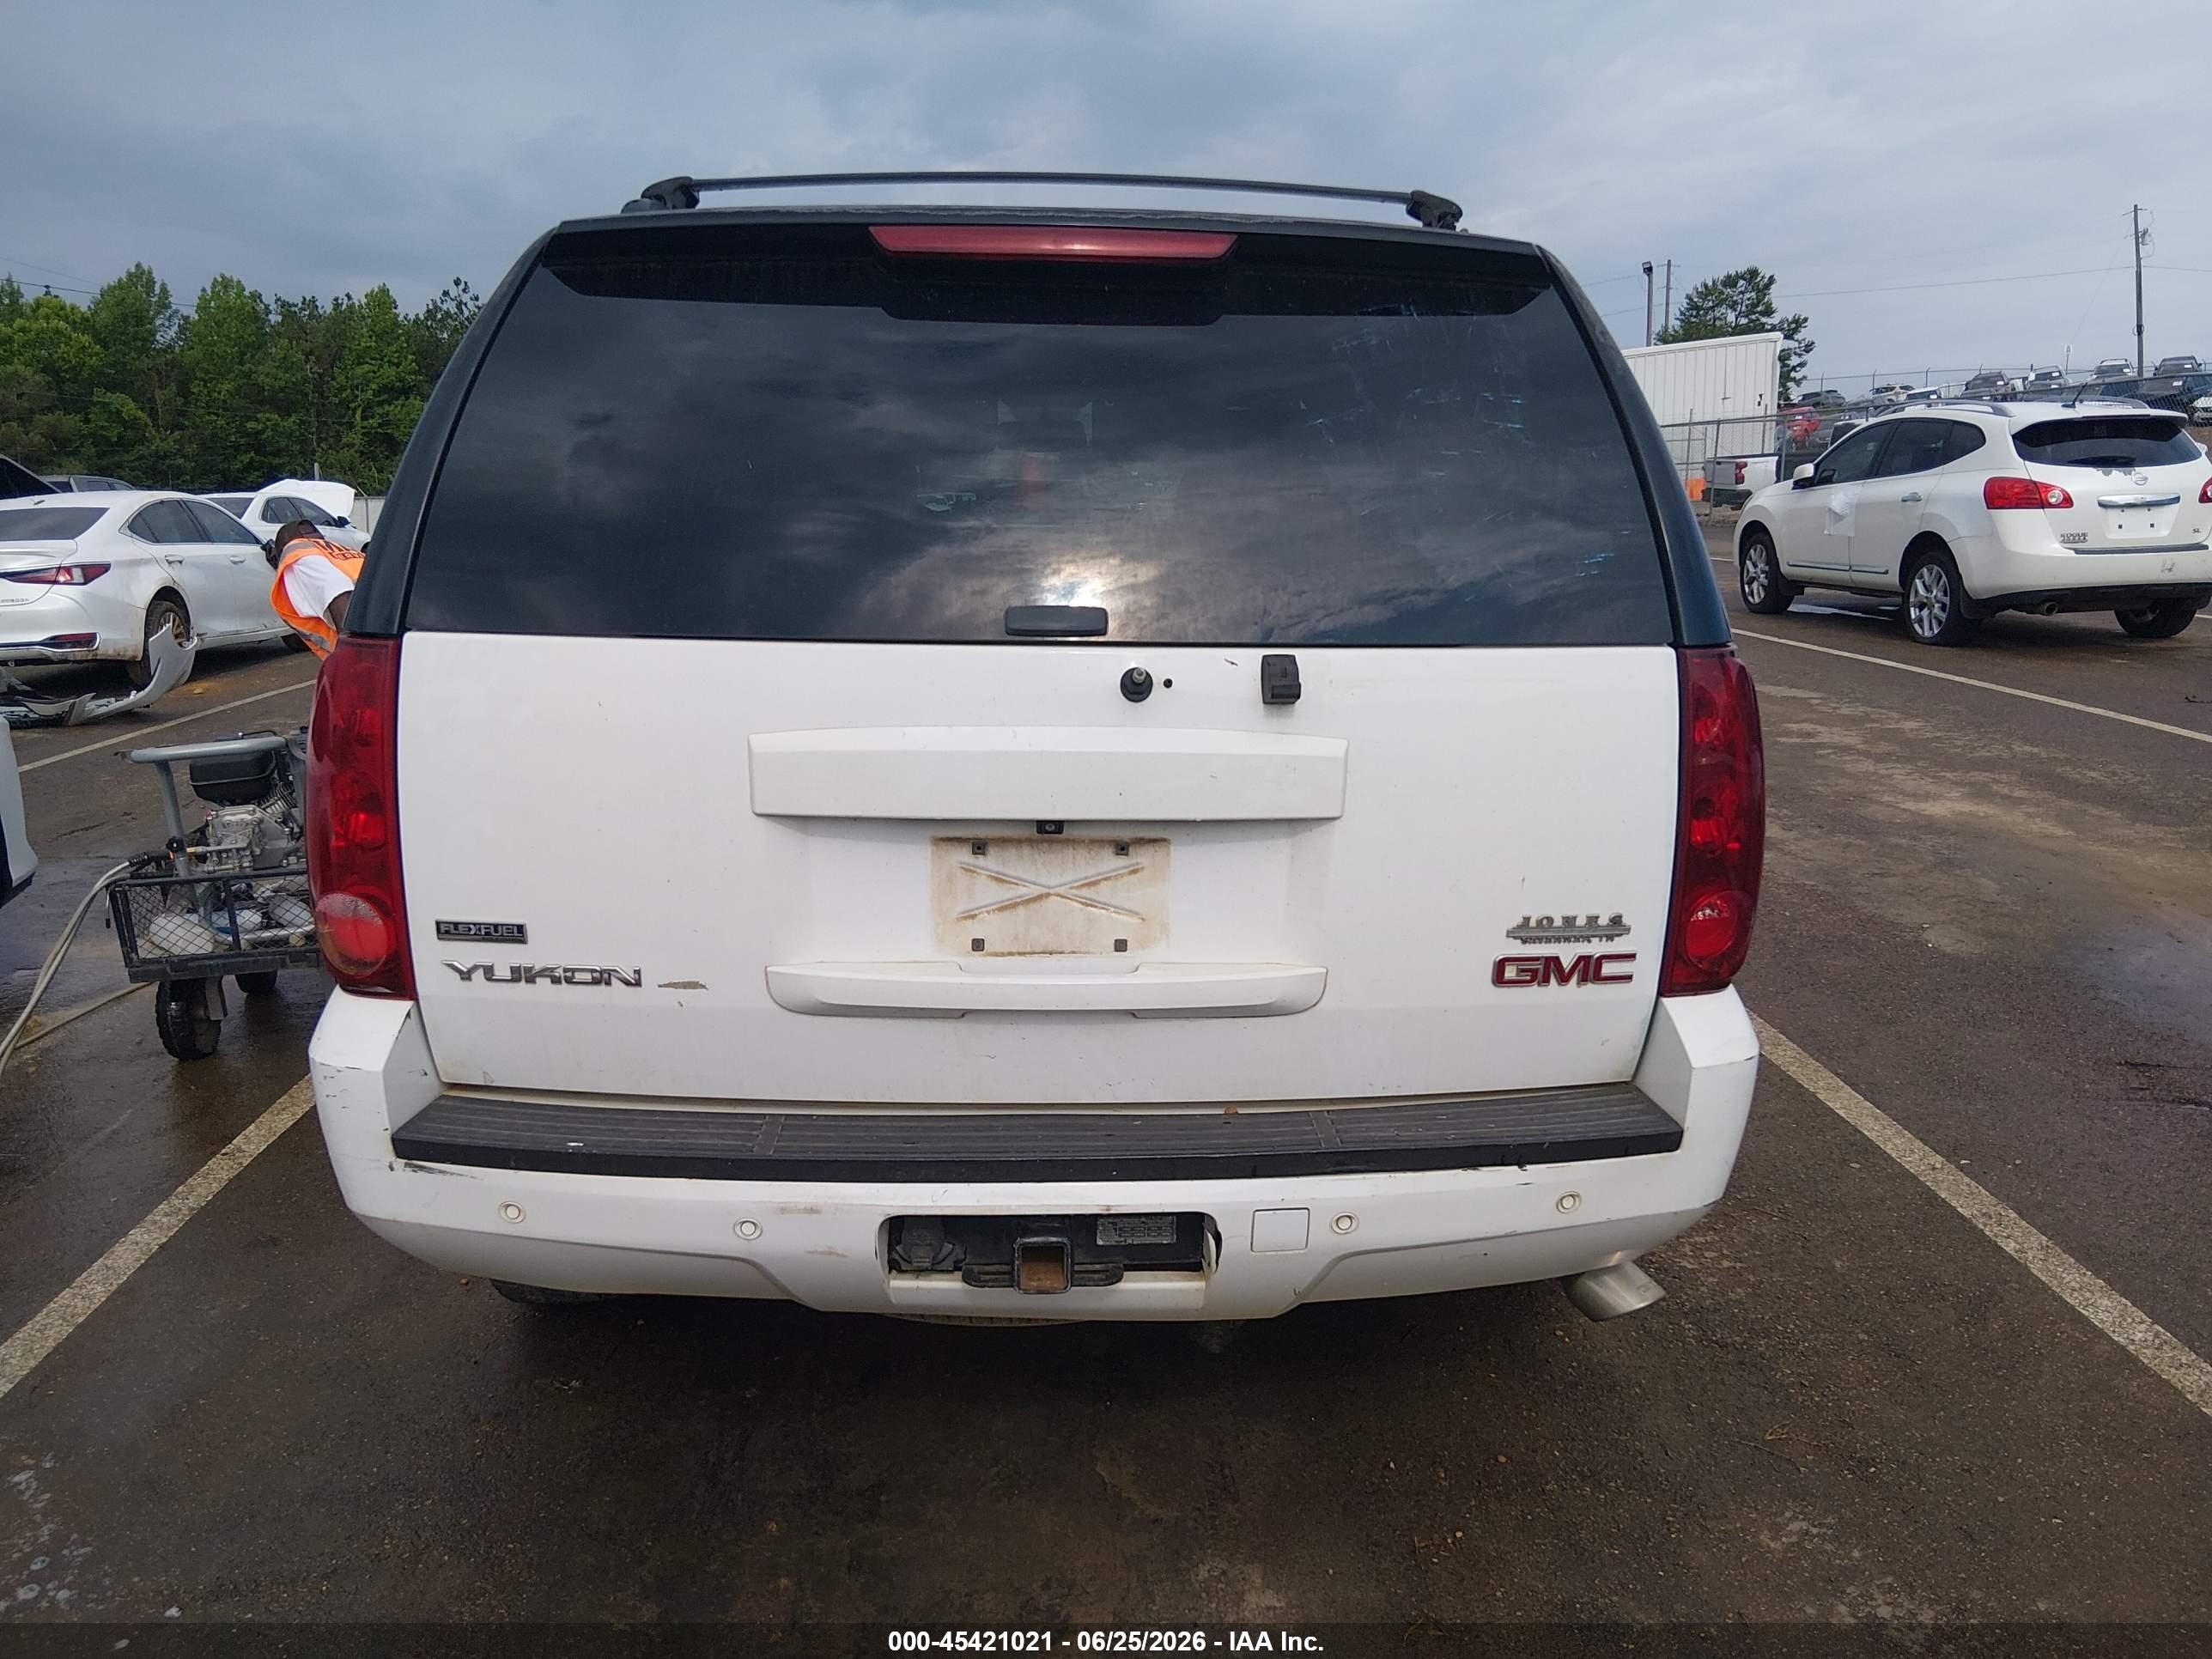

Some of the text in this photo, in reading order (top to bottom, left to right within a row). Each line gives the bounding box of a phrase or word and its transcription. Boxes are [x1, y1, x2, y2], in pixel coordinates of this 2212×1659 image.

[439, 922, 524, 937] FLEXFUEL
[1516, 912, 1626, 928] JONES
[441, 959, 642, 988] YUKON
[1492, 951, 1638, 988] GMC
